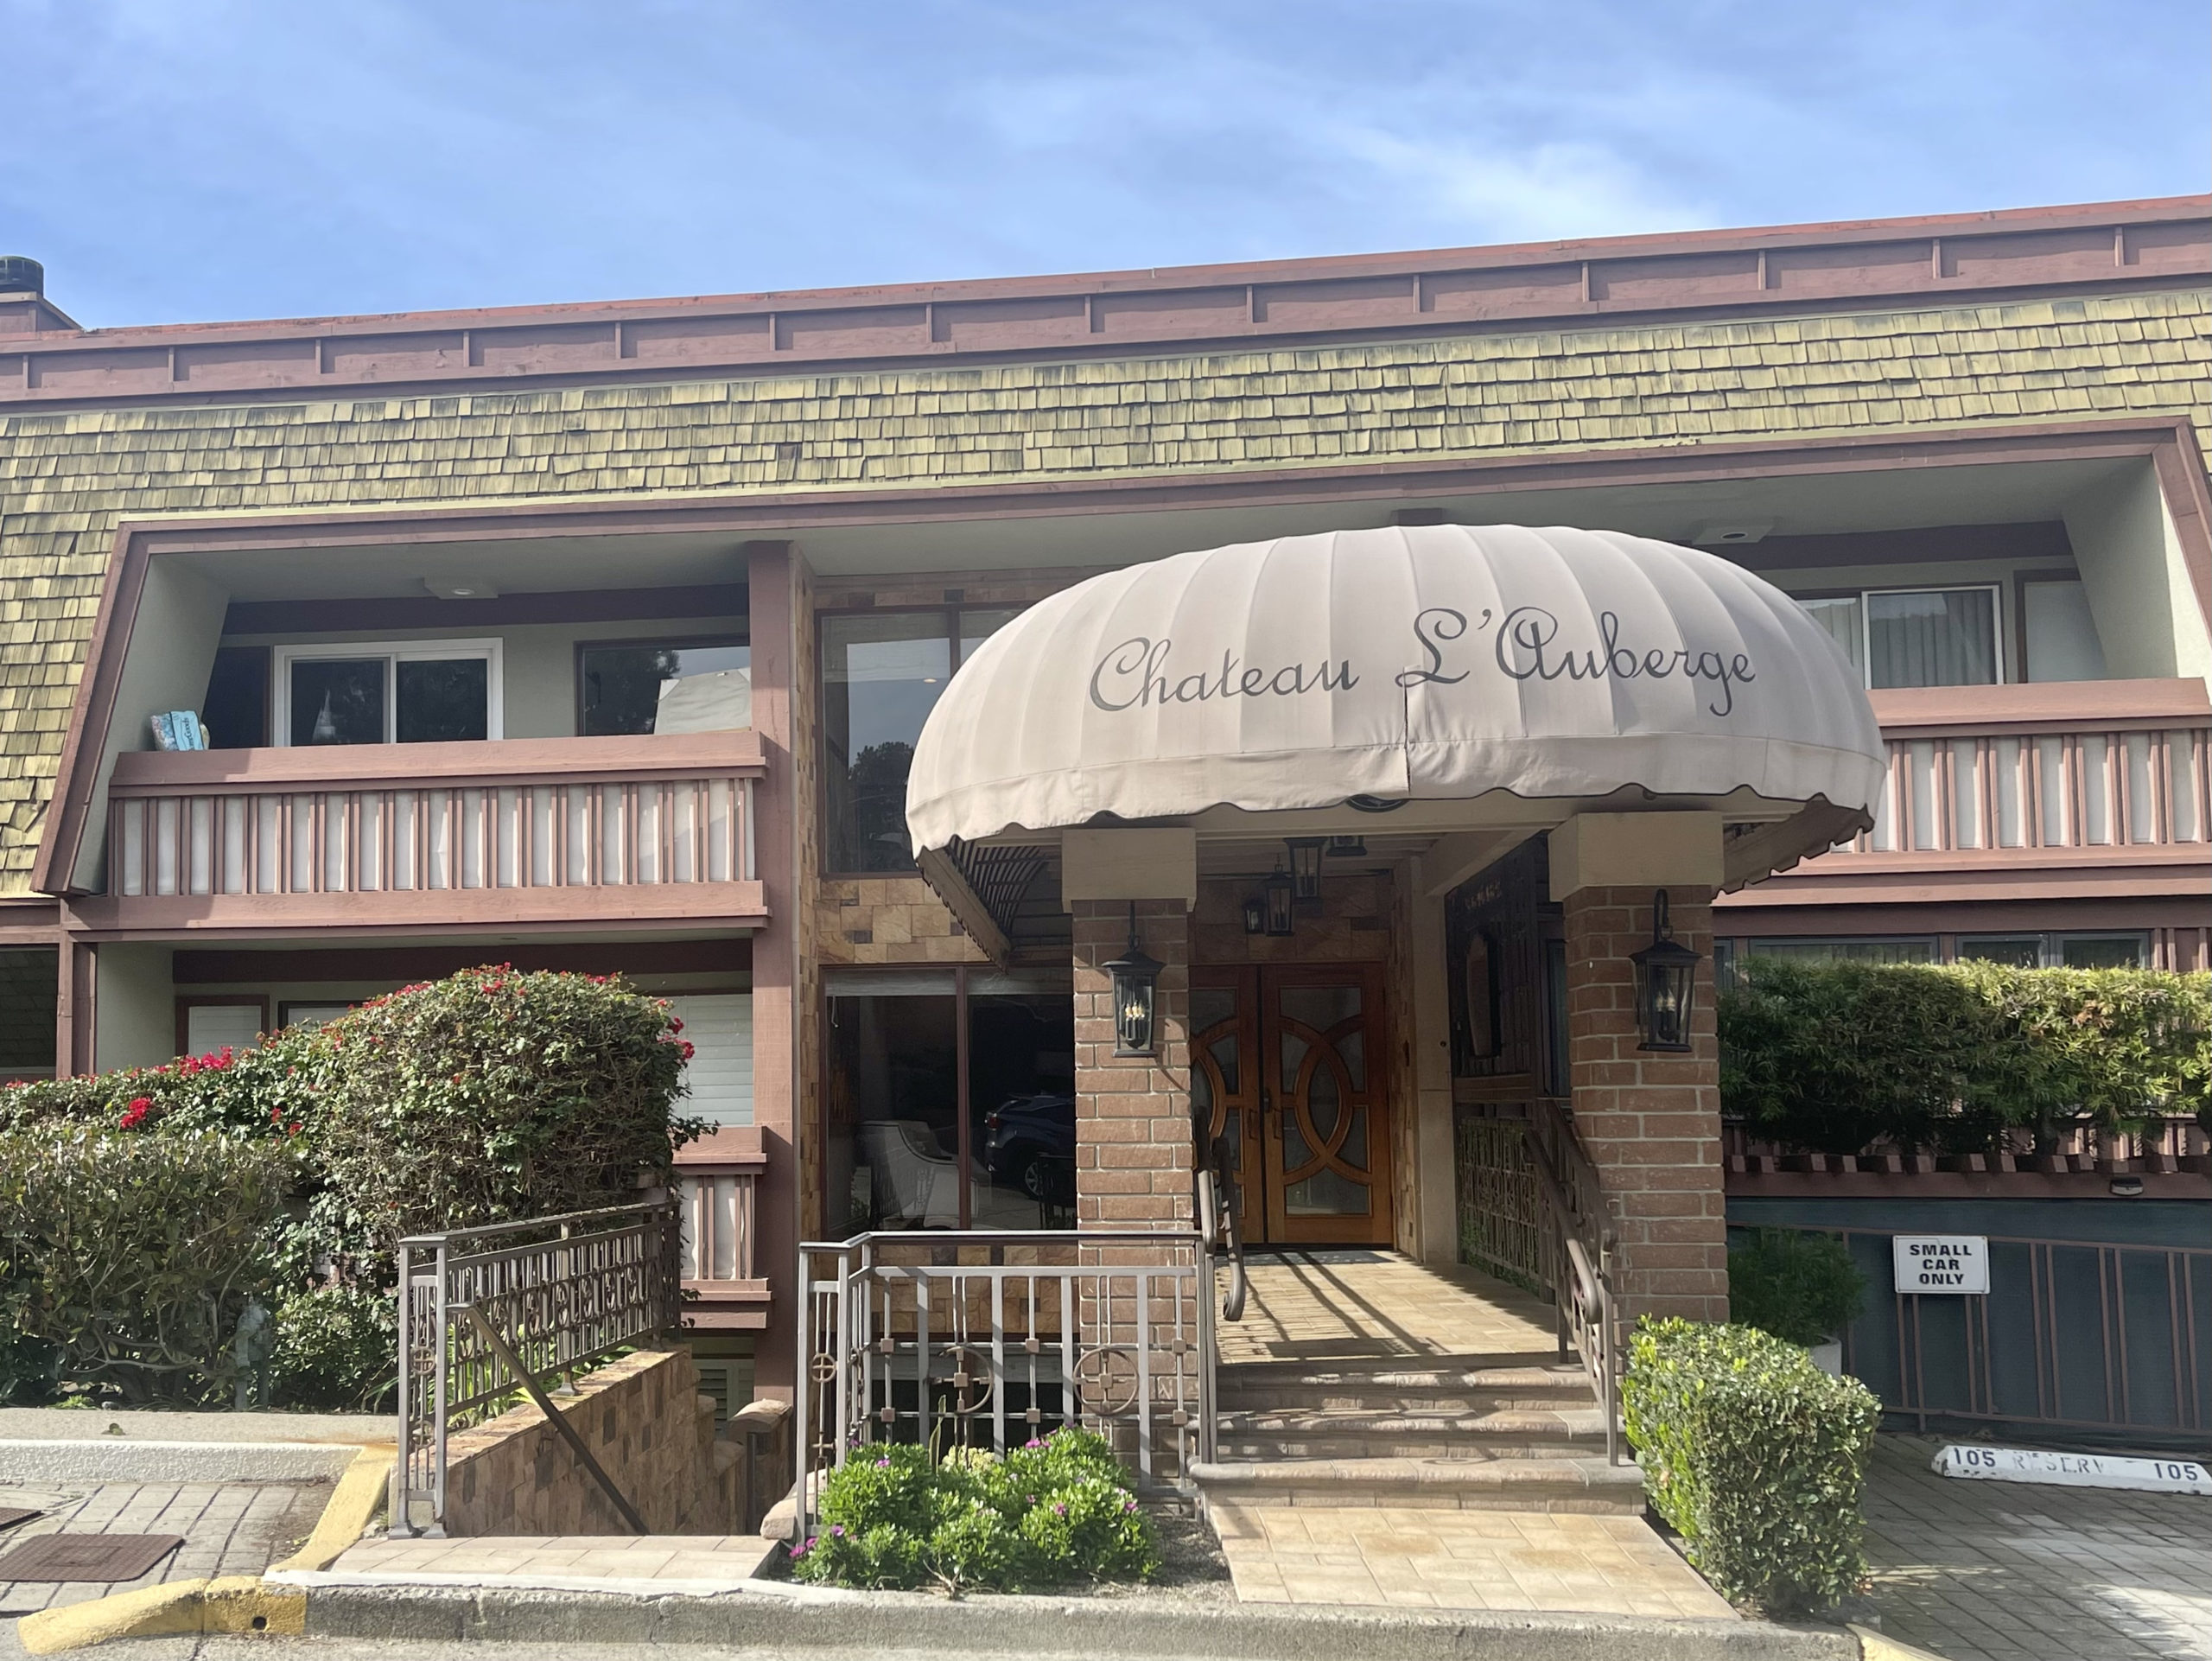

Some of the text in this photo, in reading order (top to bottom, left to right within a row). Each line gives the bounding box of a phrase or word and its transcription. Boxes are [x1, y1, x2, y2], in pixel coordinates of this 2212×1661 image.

[1089, 606, 1757, 717] Chateau L'Auberge
[1910, 1244, 1972, 1256] SMALL
[1923, 1259, 1960, 1270] CAR
[1919, 1274, 1964, 1285] ONLY
[1954, 1448, 1996, 1467] 105
[2154, 1463, 2198, 1480] 105
